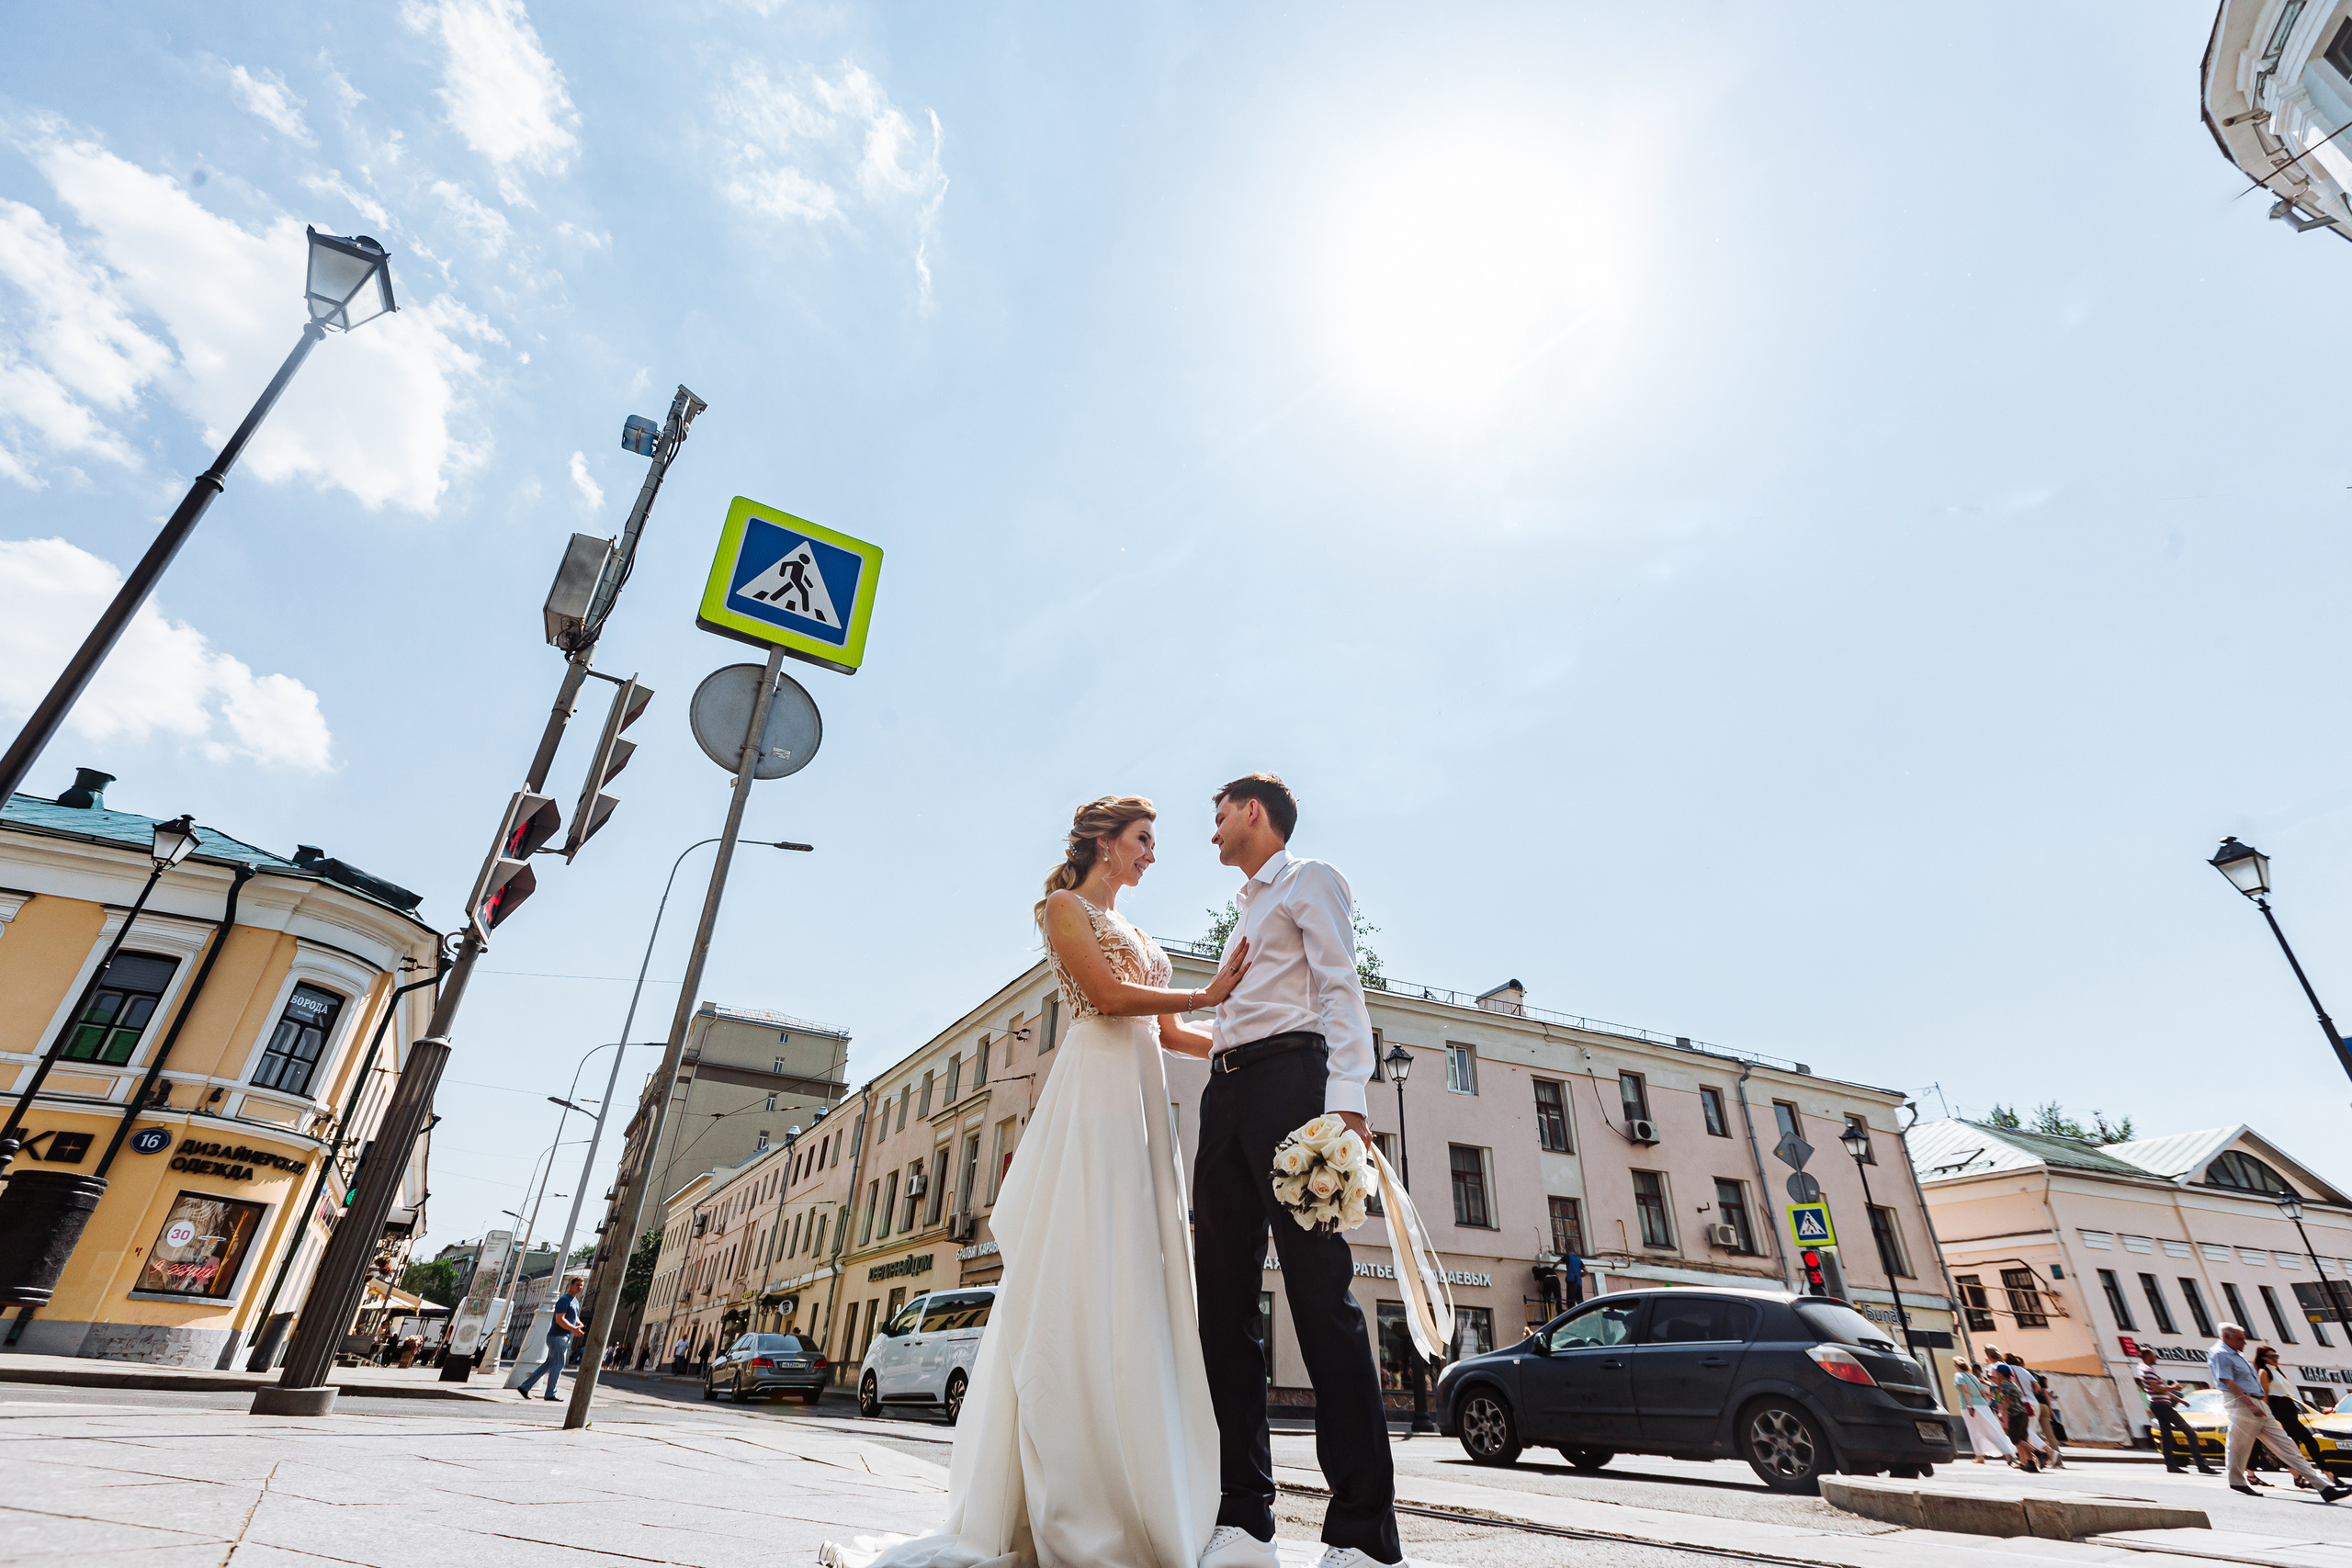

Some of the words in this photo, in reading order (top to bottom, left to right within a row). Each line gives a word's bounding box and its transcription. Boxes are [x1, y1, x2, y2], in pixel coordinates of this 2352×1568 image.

[290, 995, 328, 1014] БОРОДА
[140, 1134, 161, 1148] 16
[176, 1139, 307, 1176] ДИЗАЙНЕРСКАЯ
[170, 1156, 254, 1180] ОДЕЖДА
[171, 1229, 190, 1240] 30
[911, 1254, 934, 1277] ДОМ
[1352, 1261, 1397, 1280] РАТЬЕ
[1810, 1271, 1824, 1283] 32
